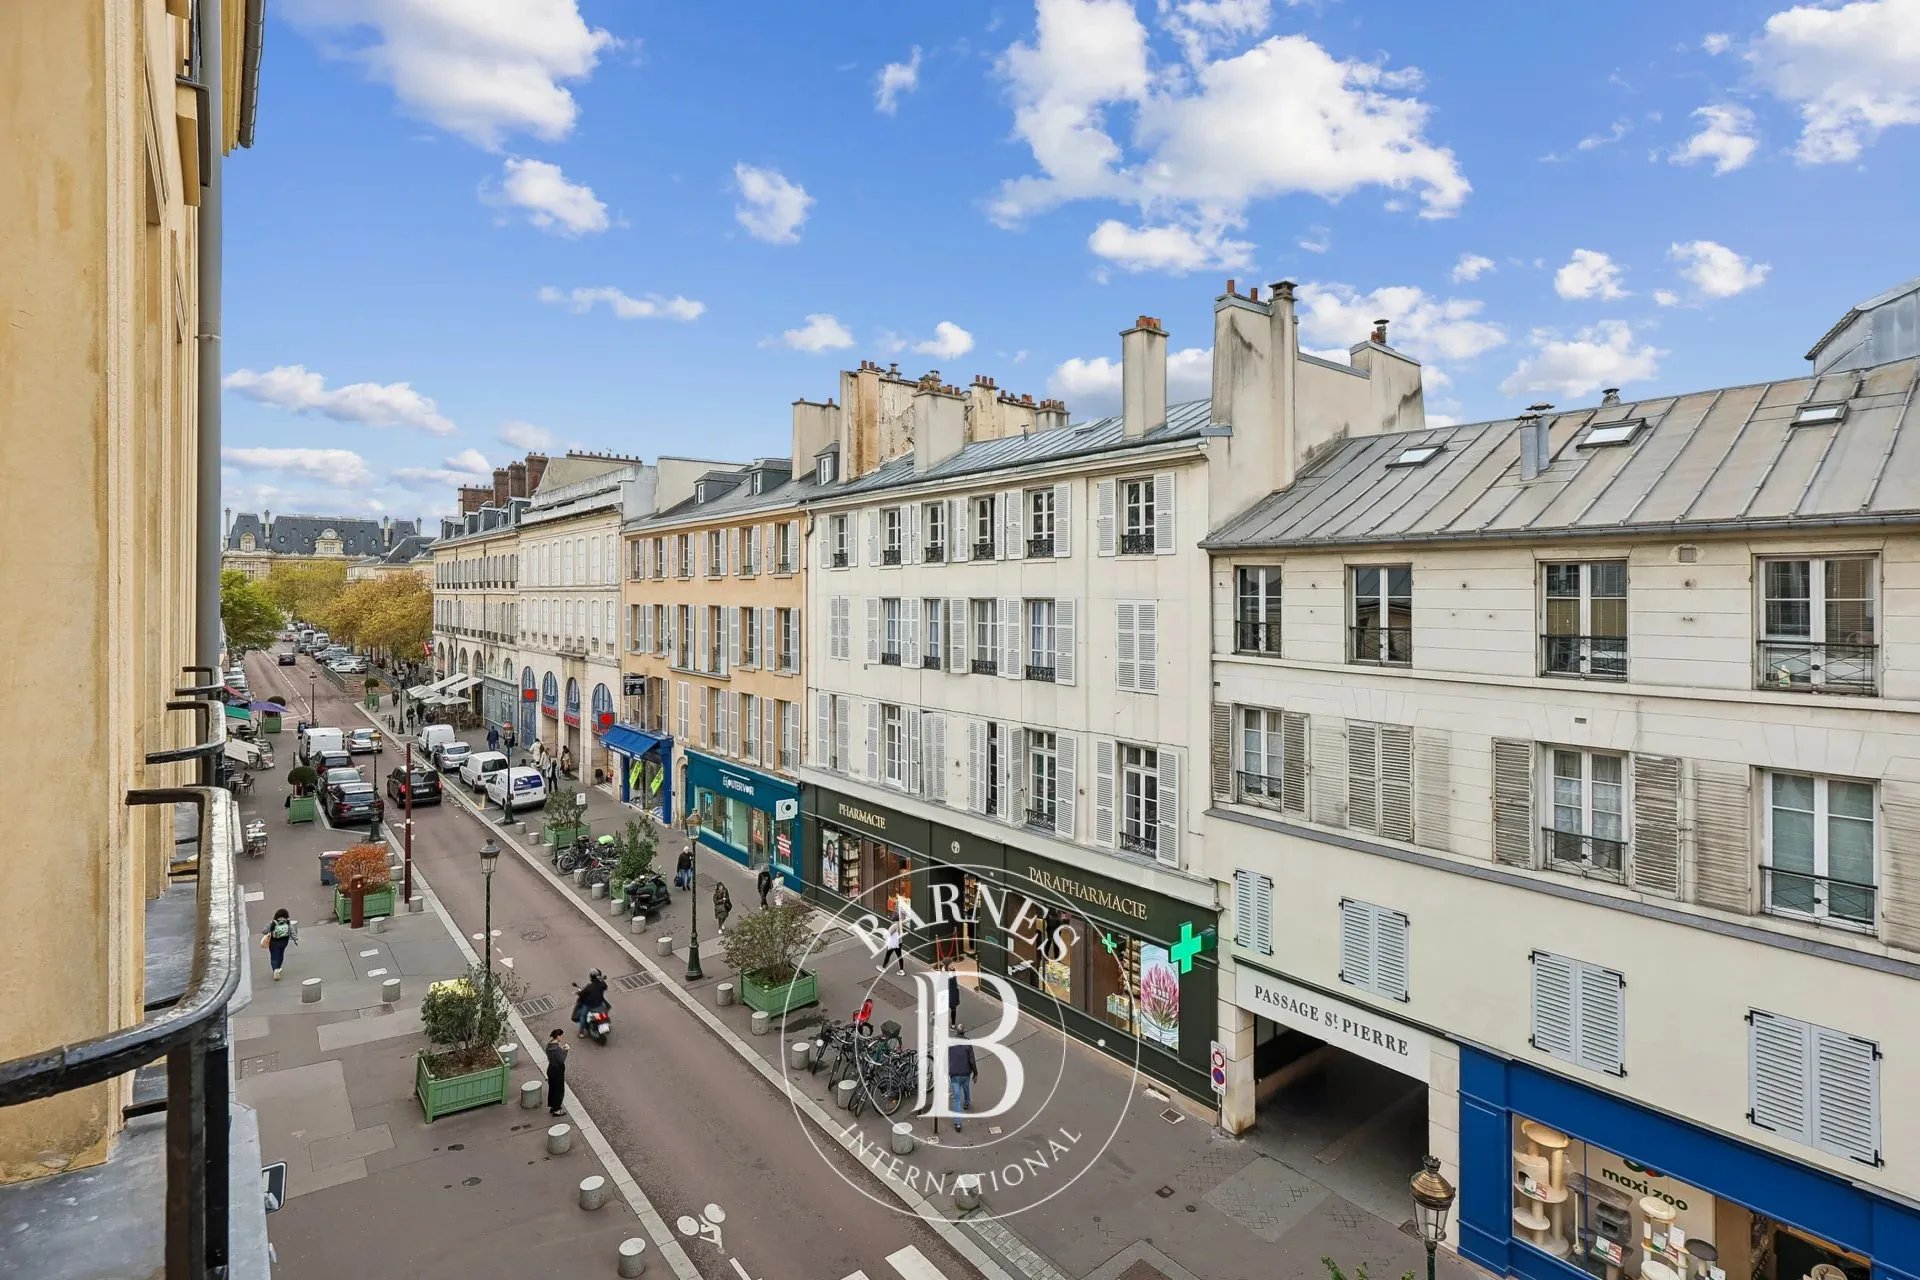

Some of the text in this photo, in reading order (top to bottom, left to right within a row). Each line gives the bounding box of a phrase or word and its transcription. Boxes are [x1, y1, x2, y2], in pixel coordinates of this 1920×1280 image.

[838, 803, 886, 830] PHARMACIE
[1028, 866, 1148, 921] PARAPHARMACIE
[1254, 984, 1319, 1022] PASSAGE
[1342, 1017, 1409, 1056] PIERRE
[1602, 1167, 1689, 1212] maxi zoo
